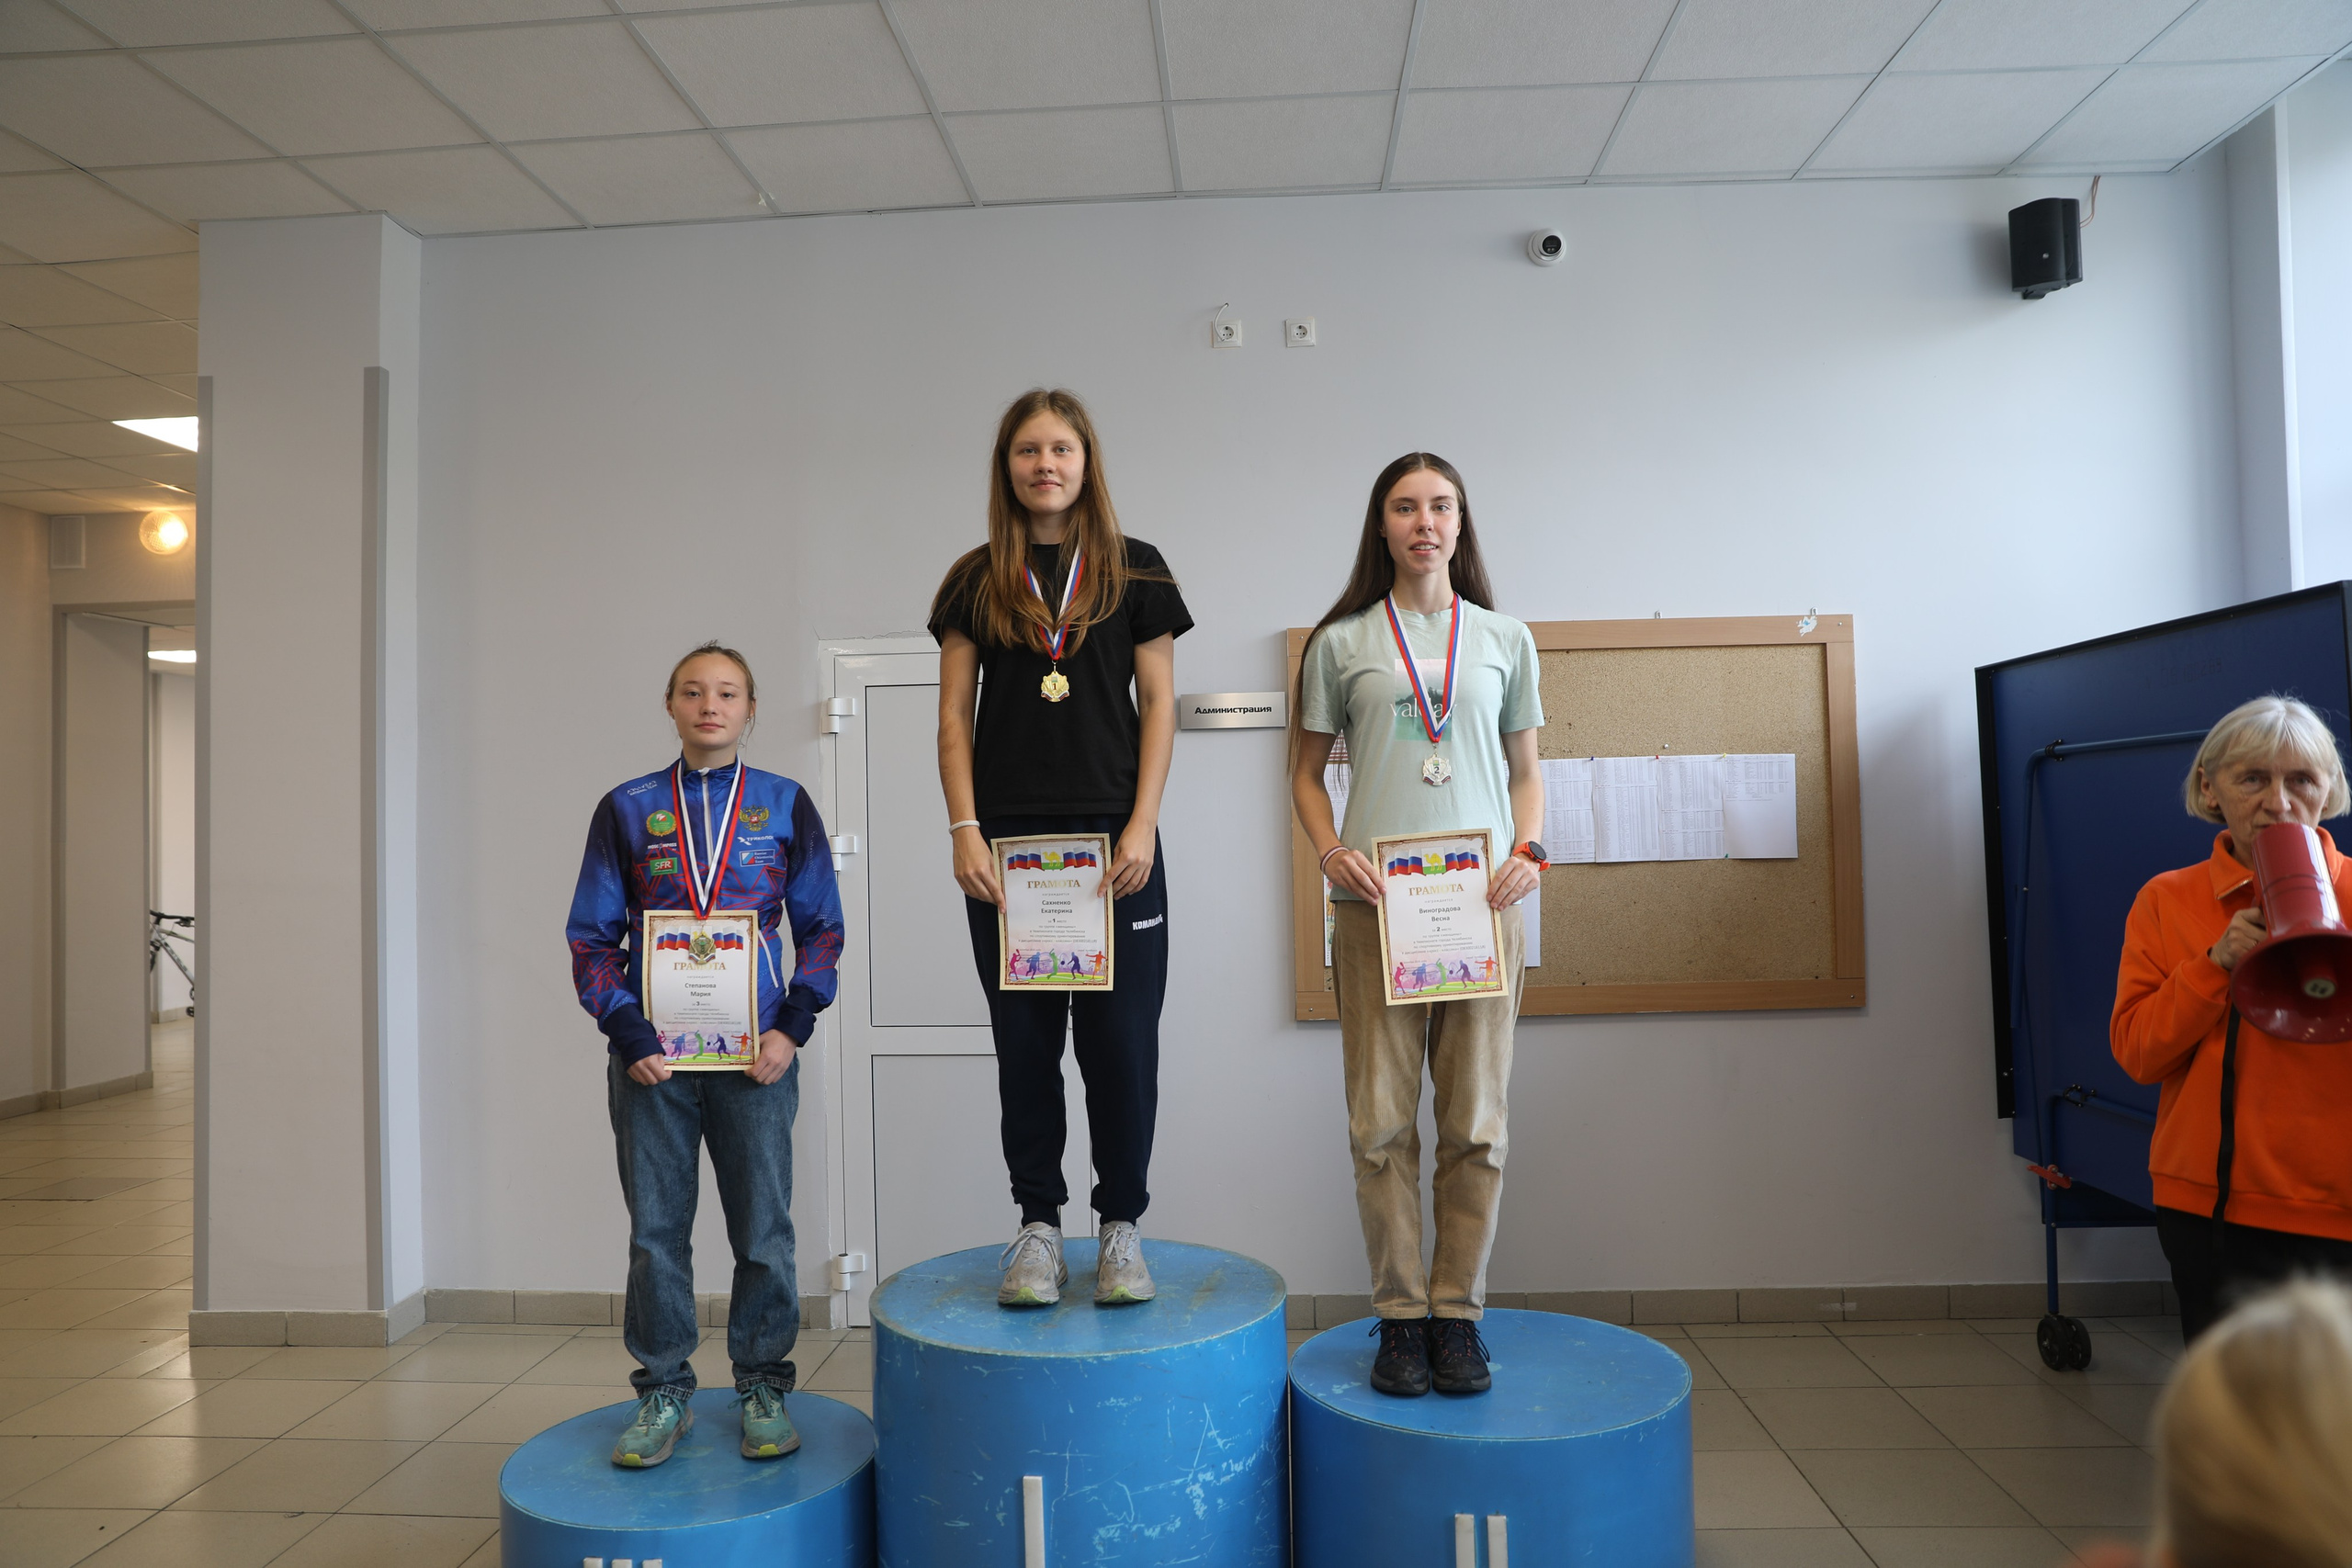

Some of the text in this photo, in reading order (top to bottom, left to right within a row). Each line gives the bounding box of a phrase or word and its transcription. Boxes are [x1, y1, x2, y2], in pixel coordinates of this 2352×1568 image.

[1194, 706, 1272, 715] Администрация
[1389, 697, 1457, 724] vala
[1434, 766, 1440, 774] 2
[654, 861, 672, 870] SFR
[1027, 879, 1081, 889] ГРАМОТА
[1409, 884, 1464, 896] ГРАМОТА
[1419, 906, 1461, 914] Виноградова
[673, 962, 727, 971] ГРАМОТА
